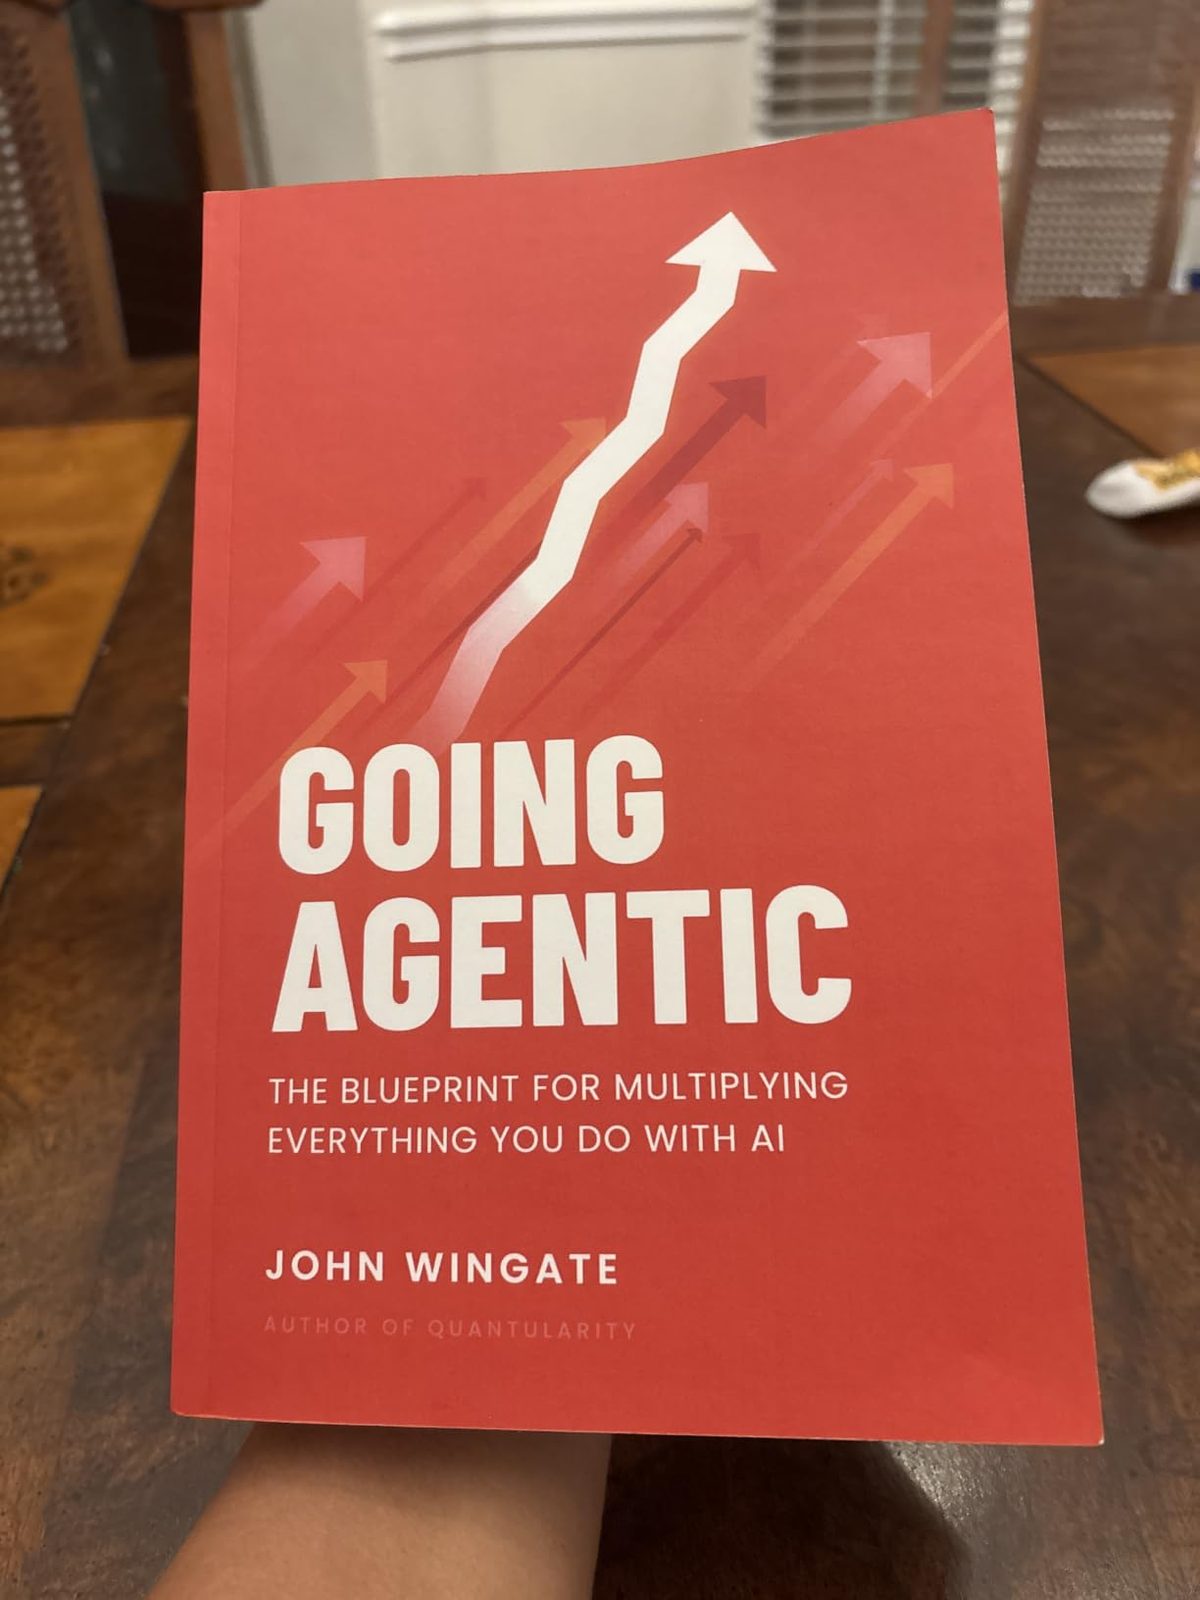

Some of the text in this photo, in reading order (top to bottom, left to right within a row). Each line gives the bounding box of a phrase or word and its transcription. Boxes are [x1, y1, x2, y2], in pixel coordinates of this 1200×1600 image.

[279, 735, 665, 875] GOING
[271, 884, 852, 1033] AGENTIC
[268, 1071, 848, 1105] THE BLUEPRINT FOR MULTIPLYING
[268, 1123, 784, 1154] EVERYTHING YOU DO WITH AI
[265, 1249, 618, 1285] JOHN WINGATE
[264, 1314, 637, 1341] AUTHOR OF QUANTULARITY
